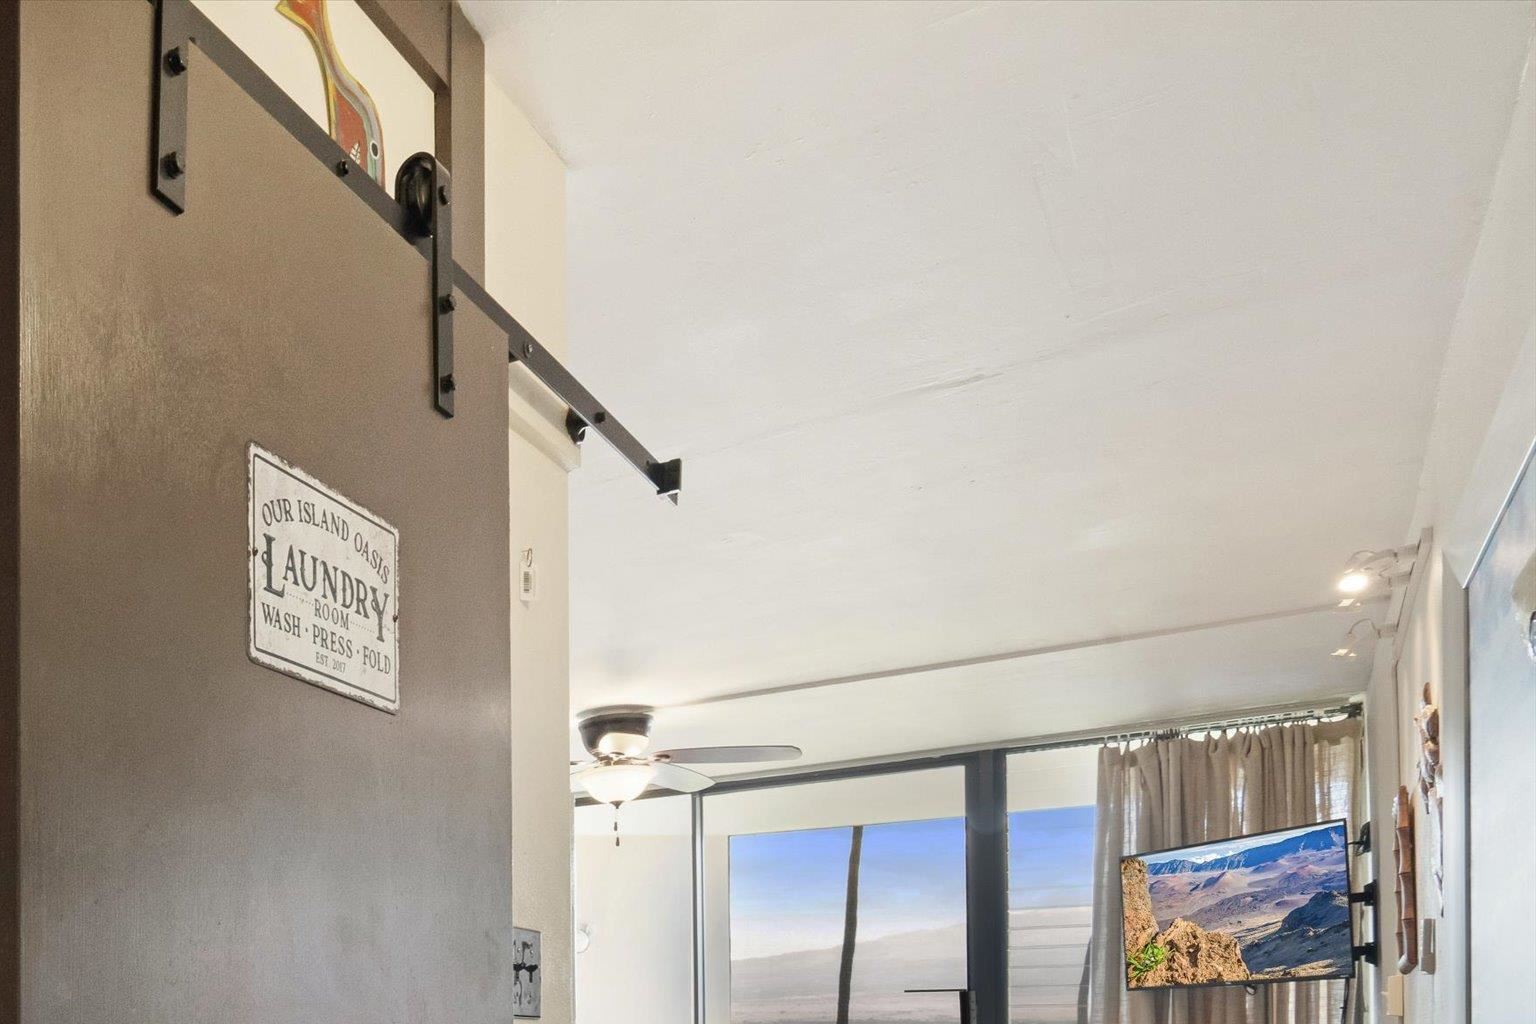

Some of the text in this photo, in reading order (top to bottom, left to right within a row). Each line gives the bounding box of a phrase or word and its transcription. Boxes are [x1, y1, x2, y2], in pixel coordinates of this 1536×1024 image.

[262, 498, 390, 584] OUR ISLAND OASIS
[261, 533, 389, 643] LAUNDRY
[314, 598, 349, 630] ROOM
[261, 602, 391, 675] WASH PRESS FOLD
